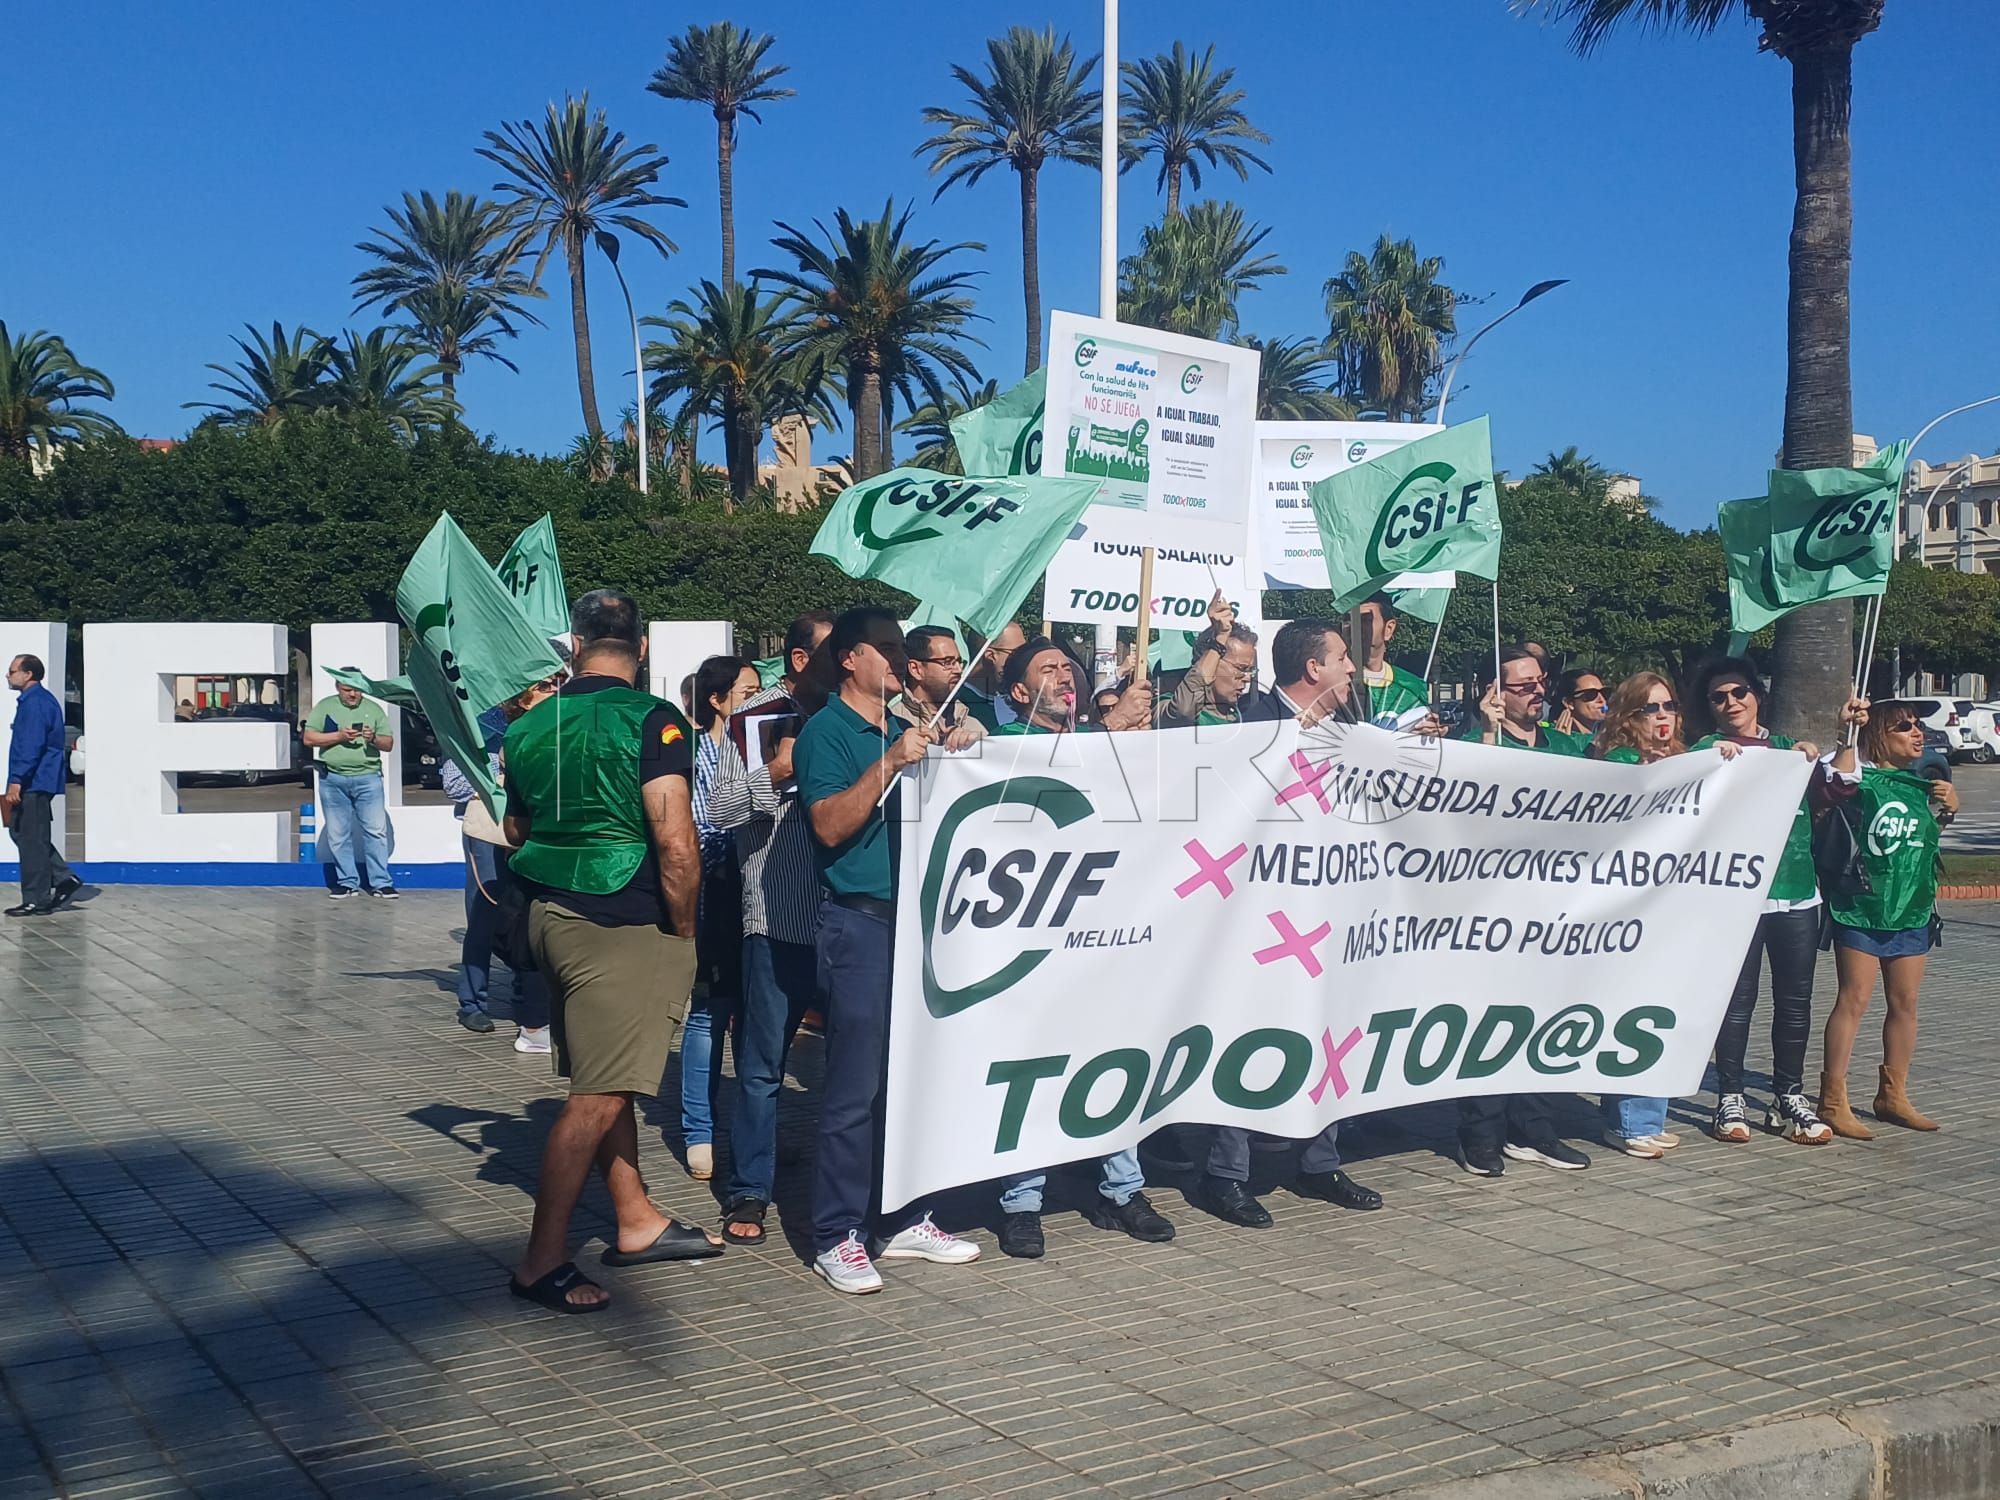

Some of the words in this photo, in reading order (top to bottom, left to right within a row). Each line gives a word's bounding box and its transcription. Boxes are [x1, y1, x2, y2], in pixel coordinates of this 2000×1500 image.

[1079, 370, 1095, 381] Con
[1096, 372, 1104, 382] la
[1105, 376, 1126, 386] salud
[1127, 379, 1137, 388] de
[1115, 361, 1157, 377] muface
[1186, 373, 1204, 385] CSIF
[1084, 395, 1098, 411] NO
[1100, 398, 1111, 414] SE
[1113, 400, 1141, 419] JUEGA
[1156, 406, 1163, 418] A
[1164, 406, 1186, 422] IGUAL
[1188, 410, 1221, 429] TRABAJO,
[1161, 428, 1183, 444] IGUAL
[1185, 432, 1215, 449] SALARIO
[1268, 481, 1274, 491] A
[1276, 481, 1299, 491] IGUAL
[1275, 499, 1299, 509] IGUAL
[1093, 541, 1144, 558] IGUA
[1069, 588, 1241, 619] TODOTODS
[1501, 786, 1645, 824] SALARIAL
[1248, 840, 1380, 887] MEJORES
[1383, 841, 1588, 884] CONDICIONES
[1590, 850, 1765, 890] LABORALES
[940, 847, 1121, 936] CSIF
[1064, 924, 1153, 950] MELILLA
[1343, 908, 1388, 965] MÁS
[1392, 915, 1513, 953] EMPLEO
[1517, 912, 1644, 956] PÚBLICO
